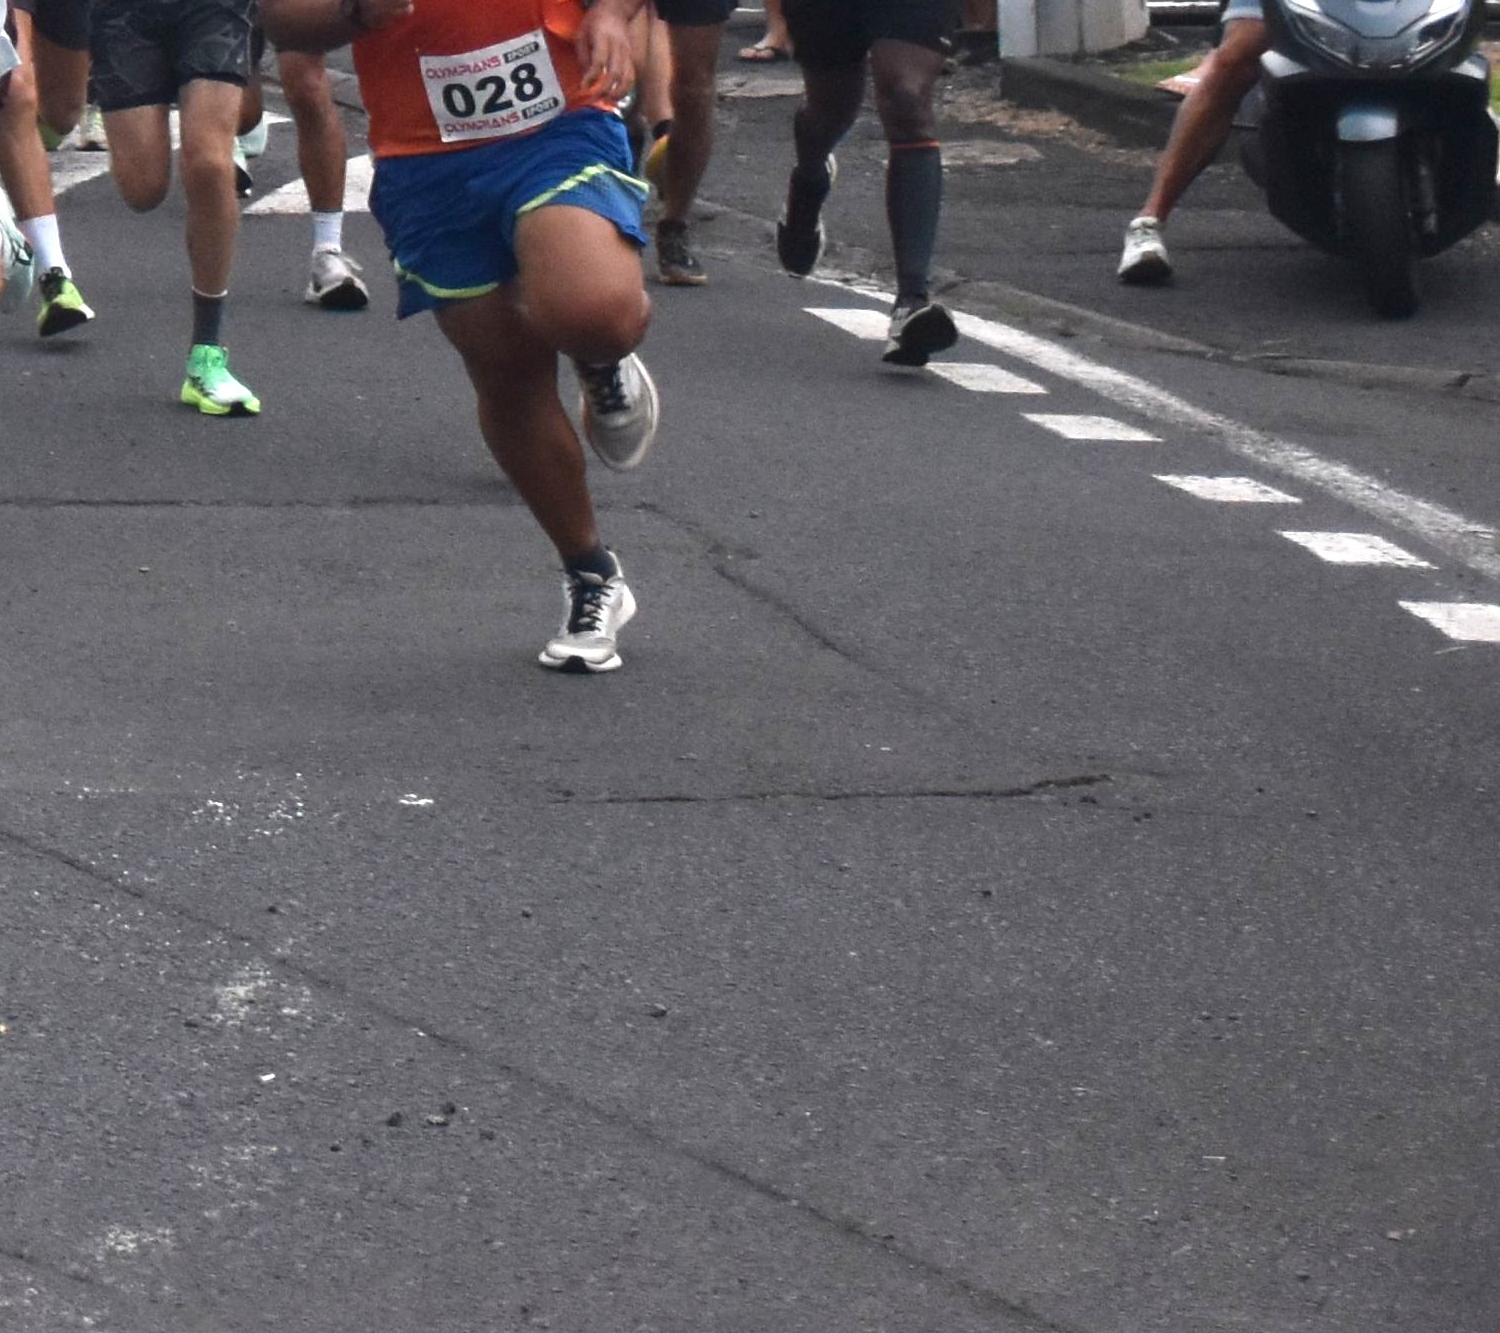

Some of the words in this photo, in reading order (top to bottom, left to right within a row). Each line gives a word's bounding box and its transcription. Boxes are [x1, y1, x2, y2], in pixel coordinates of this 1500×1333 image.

[426, 56, 502, 80] OLYMPIANS
[442, 62, 544, 119] 028
[444, 112, 521, 134] OLYMPIANS
